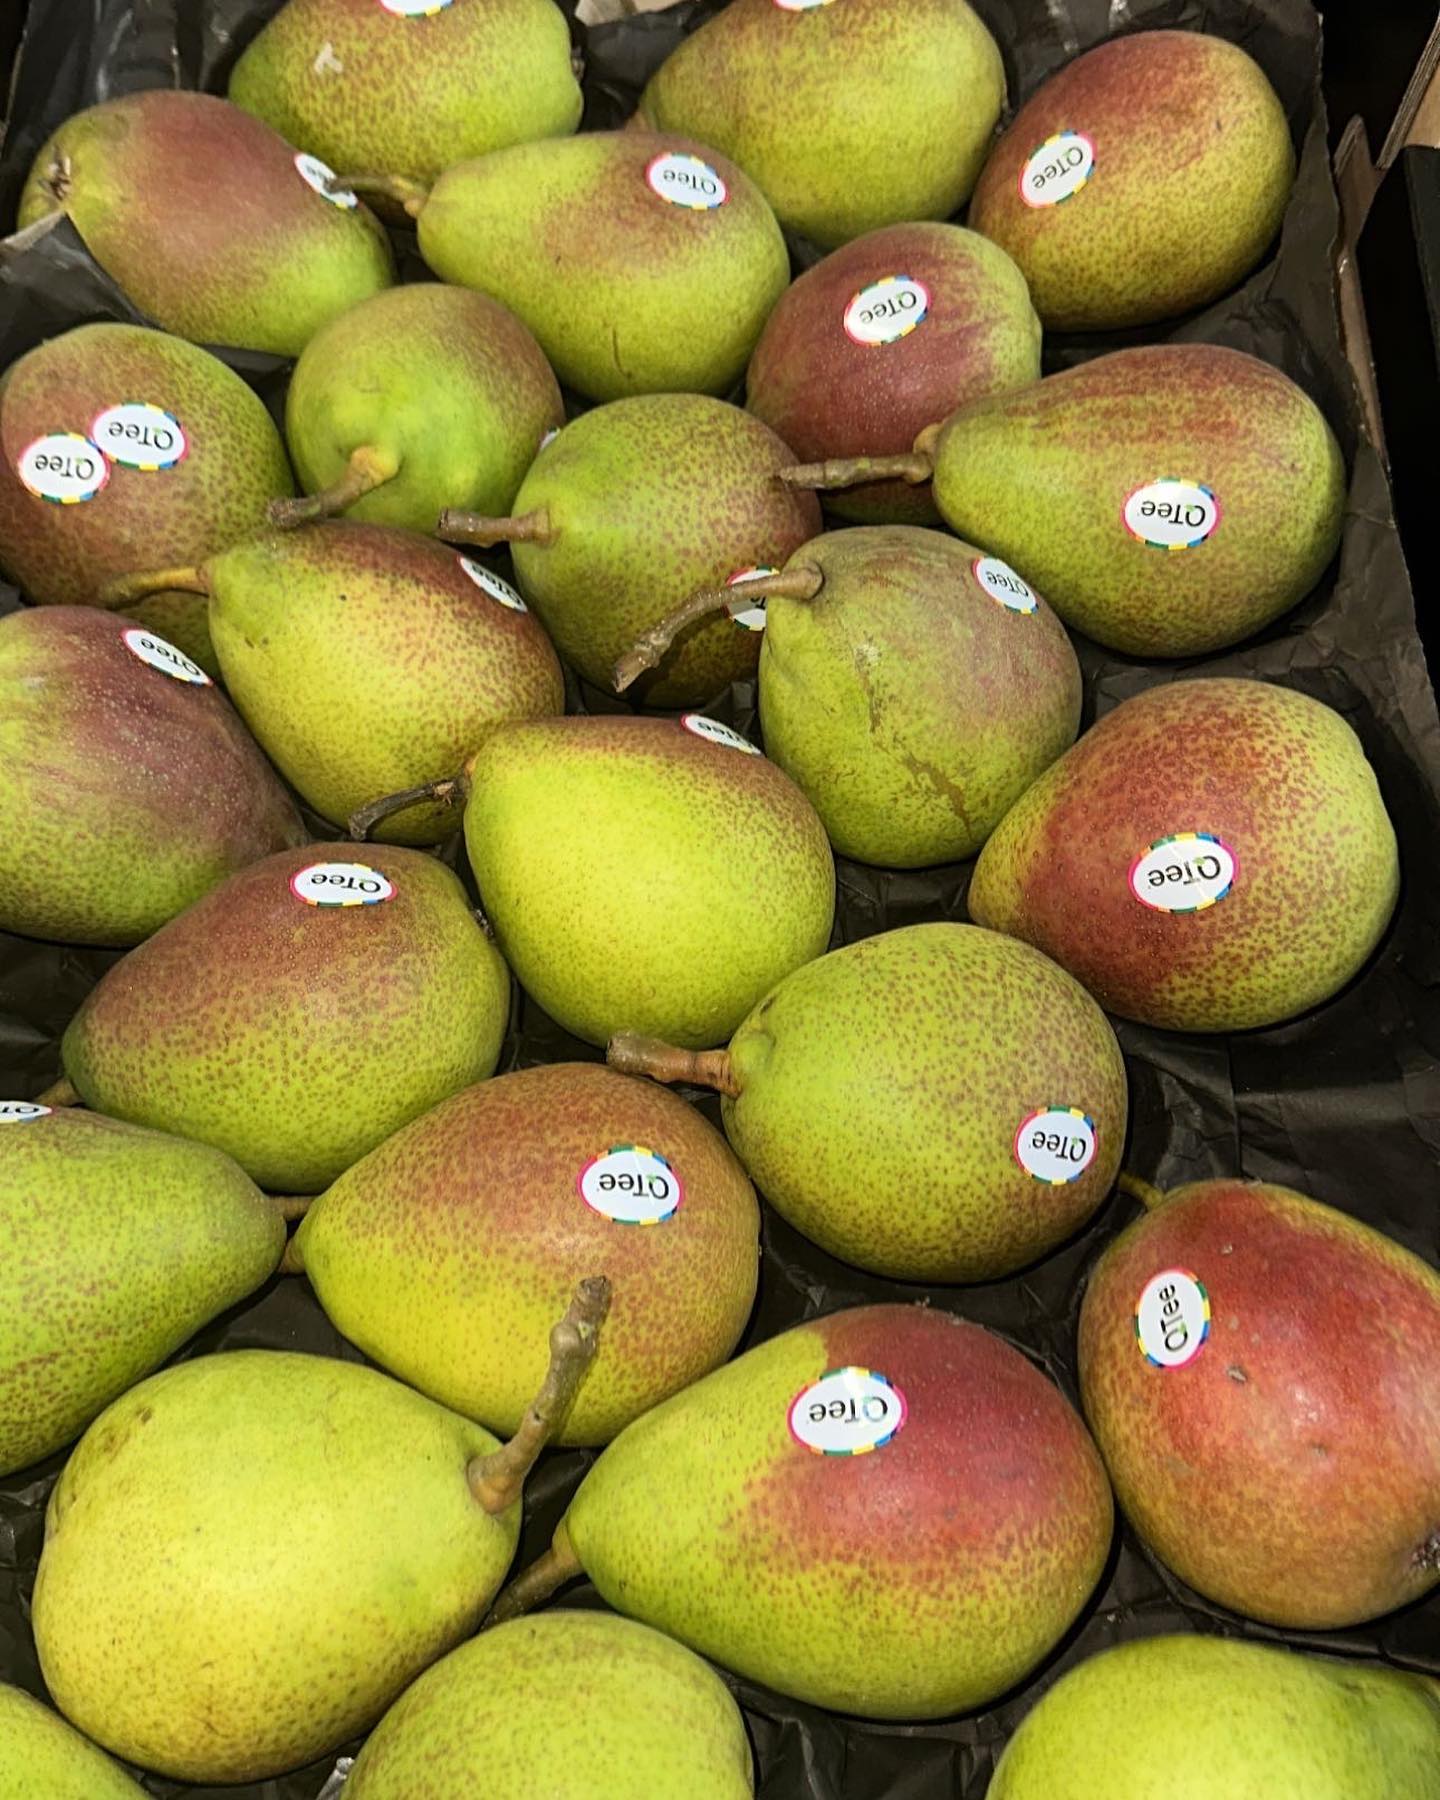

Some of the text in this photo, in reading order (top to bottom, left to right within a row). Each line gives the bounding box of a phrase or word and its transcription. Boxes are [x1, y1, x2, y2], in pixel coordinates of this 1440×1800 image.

[1033, 147, 1083, 189] QTee
[663, 169, 716, 195] QTee
[859, 291, 917, 324] QTee
[109, 422, 173, 450] QTee
[35, 454, 94, 480] QTee
[1141, 501, 1205, 527] QTee
[986, 571, 1029, 598] QTee
[141, 638, 200, 677] QTee
[311, 874, 380, 893] QTee
[1149, 856, 1221, 887] QTee
[1032, 1131, 1086, 1161] QTee
[600, 1174, 669, 1199] QTee
[1160, 1284, 1187, 1351] QTee
[809, 1397, 888, 1423] QTee
